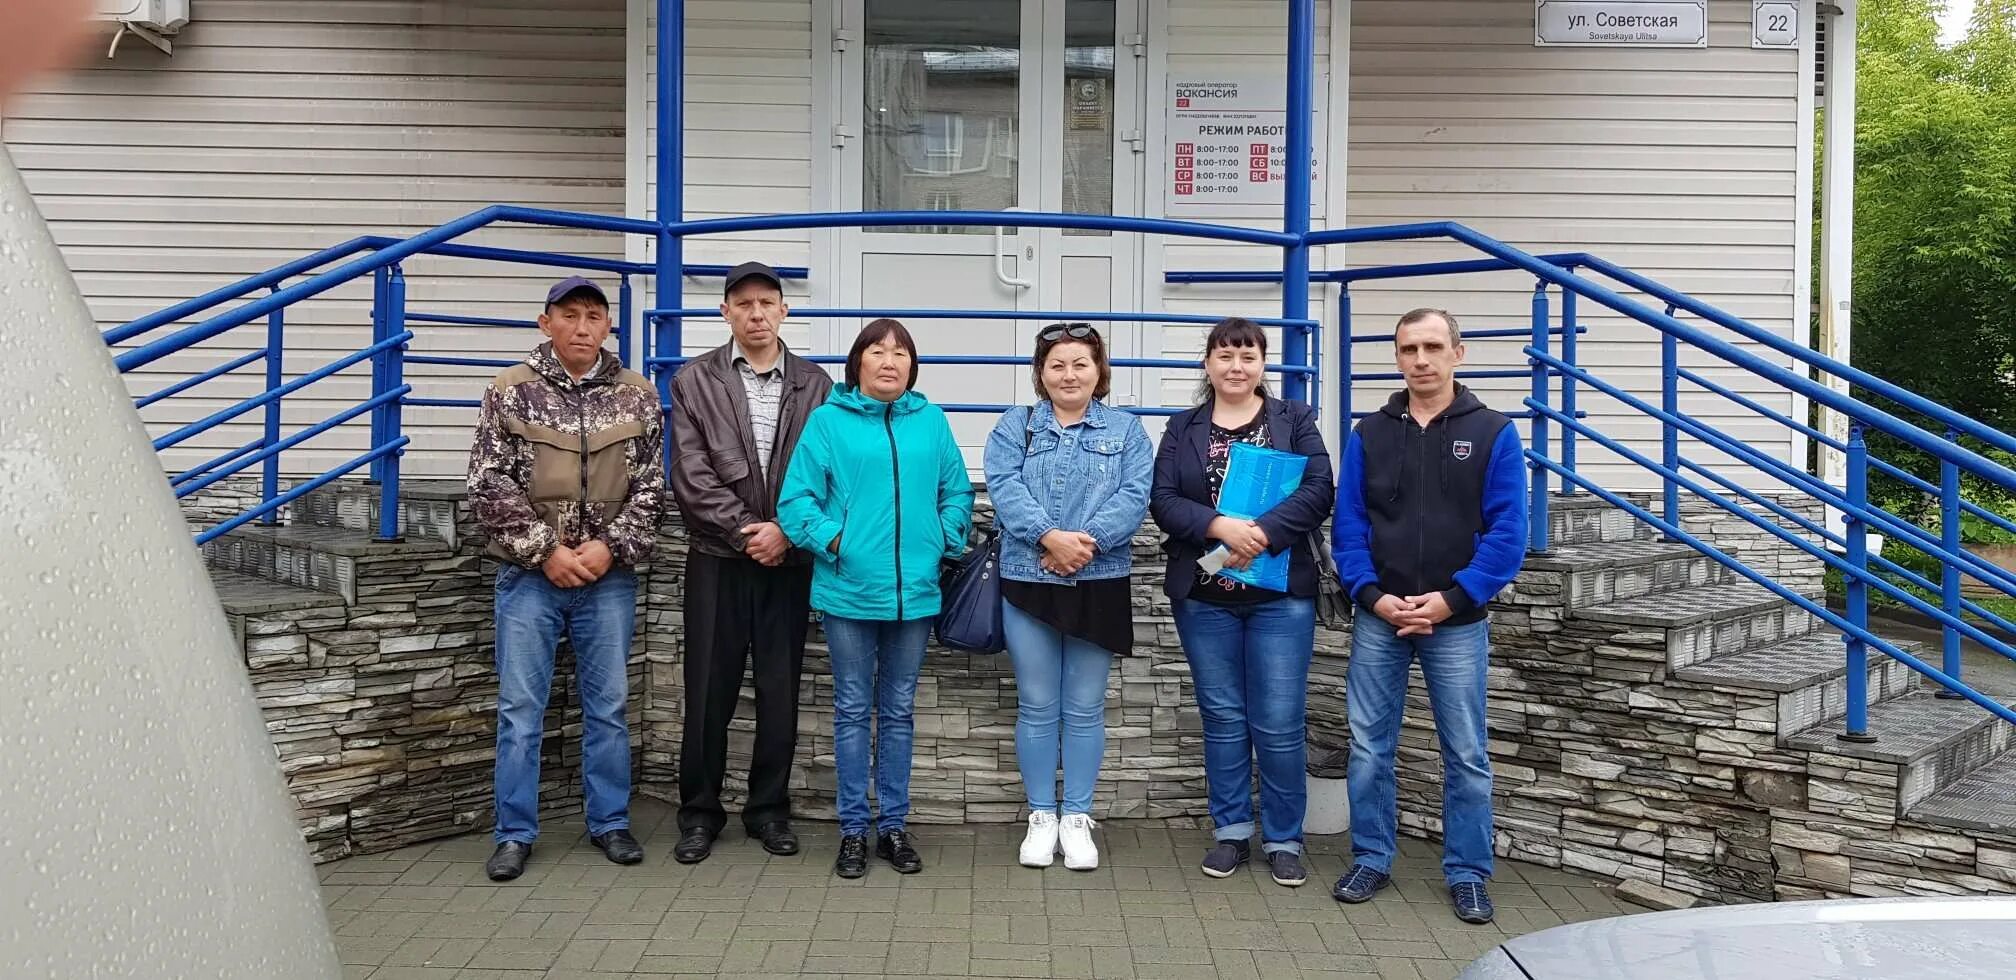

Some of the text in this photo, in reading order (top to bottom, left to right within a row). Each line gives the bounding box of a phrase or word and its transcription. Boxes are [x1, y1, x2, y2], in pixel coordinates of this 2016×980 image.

[1568, 12, 1678, 30] ул. Советская
[1768, 15, 1788, 32] 22
[1589, 32, 1658, 41] Sovetskaya Ulitsa
[1199, 126, 1286, 136] РЕЖИМ РАБОТ
[1177, 145, 1239, 153] ПН 8:00-17:00
[1252, 145, 1266, 153] ПТ
[1177, 158, 1191, 167] ВТ
[1252, 159, 1266, 167] СБ
[1177, 171, 1191, 180] СР
[1252, 172, 1266, 180] ВС
[1177, 185, 1191, 193] ЧТ
